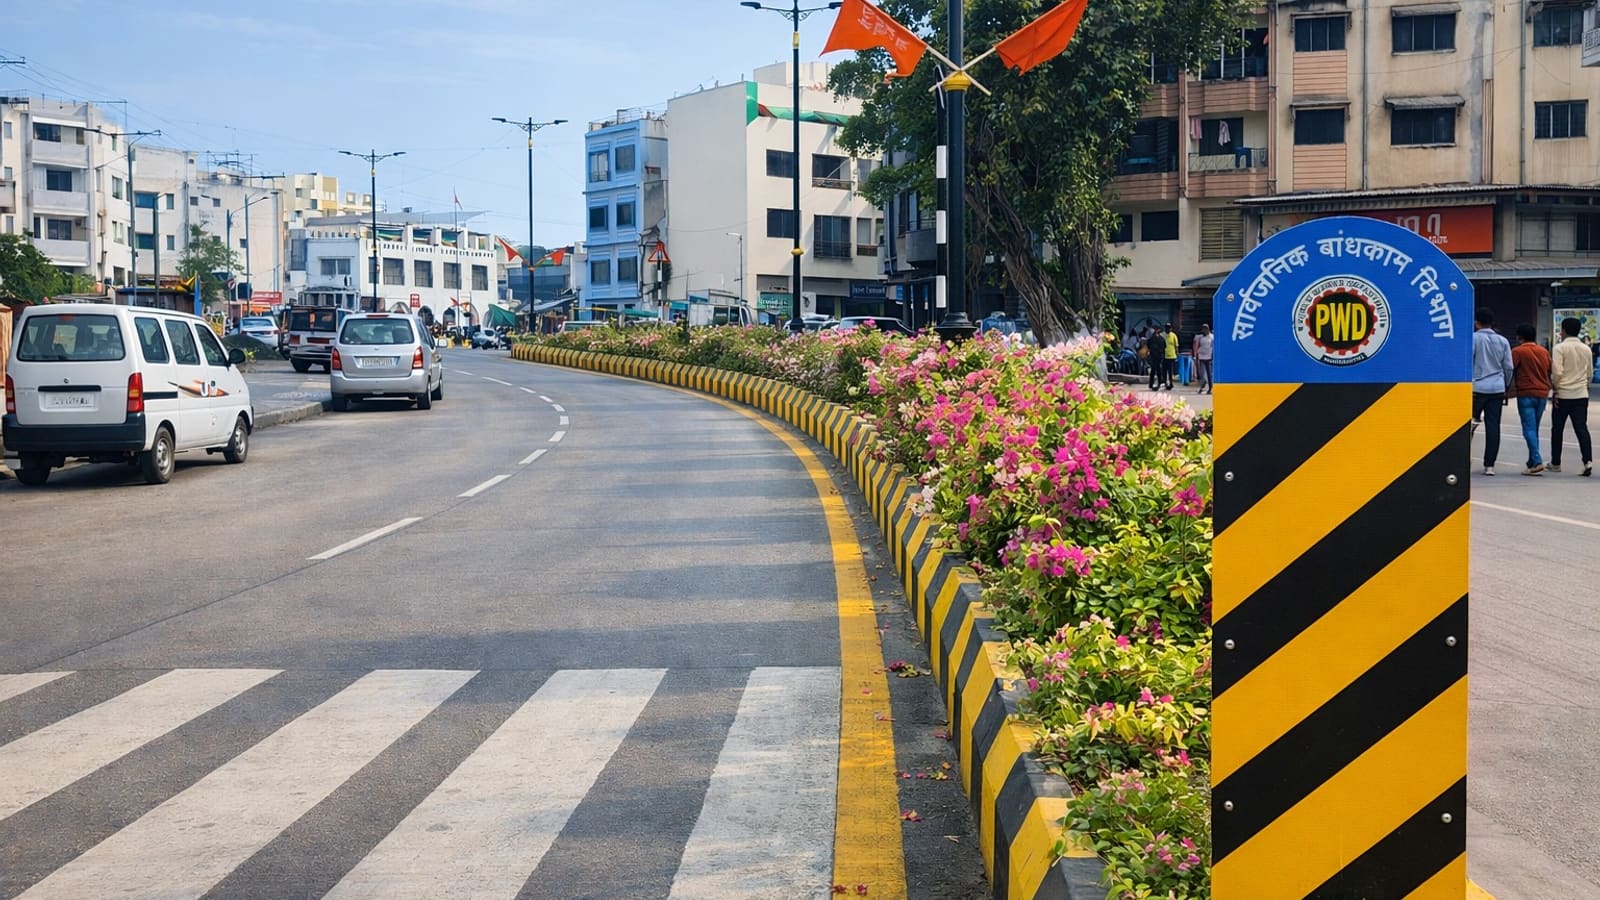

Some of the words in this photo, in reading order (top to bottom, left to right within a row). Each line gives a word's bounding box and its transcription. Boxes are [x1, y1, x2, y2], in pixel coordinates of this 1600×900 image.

[1232, 244, 1309, 341] सार्वजनिक
[1316, 229, 1413, 275] बांधकाम
[1411, 265, 1454, 339] विभाग
[1315, 302, 1367, 343] PWD
